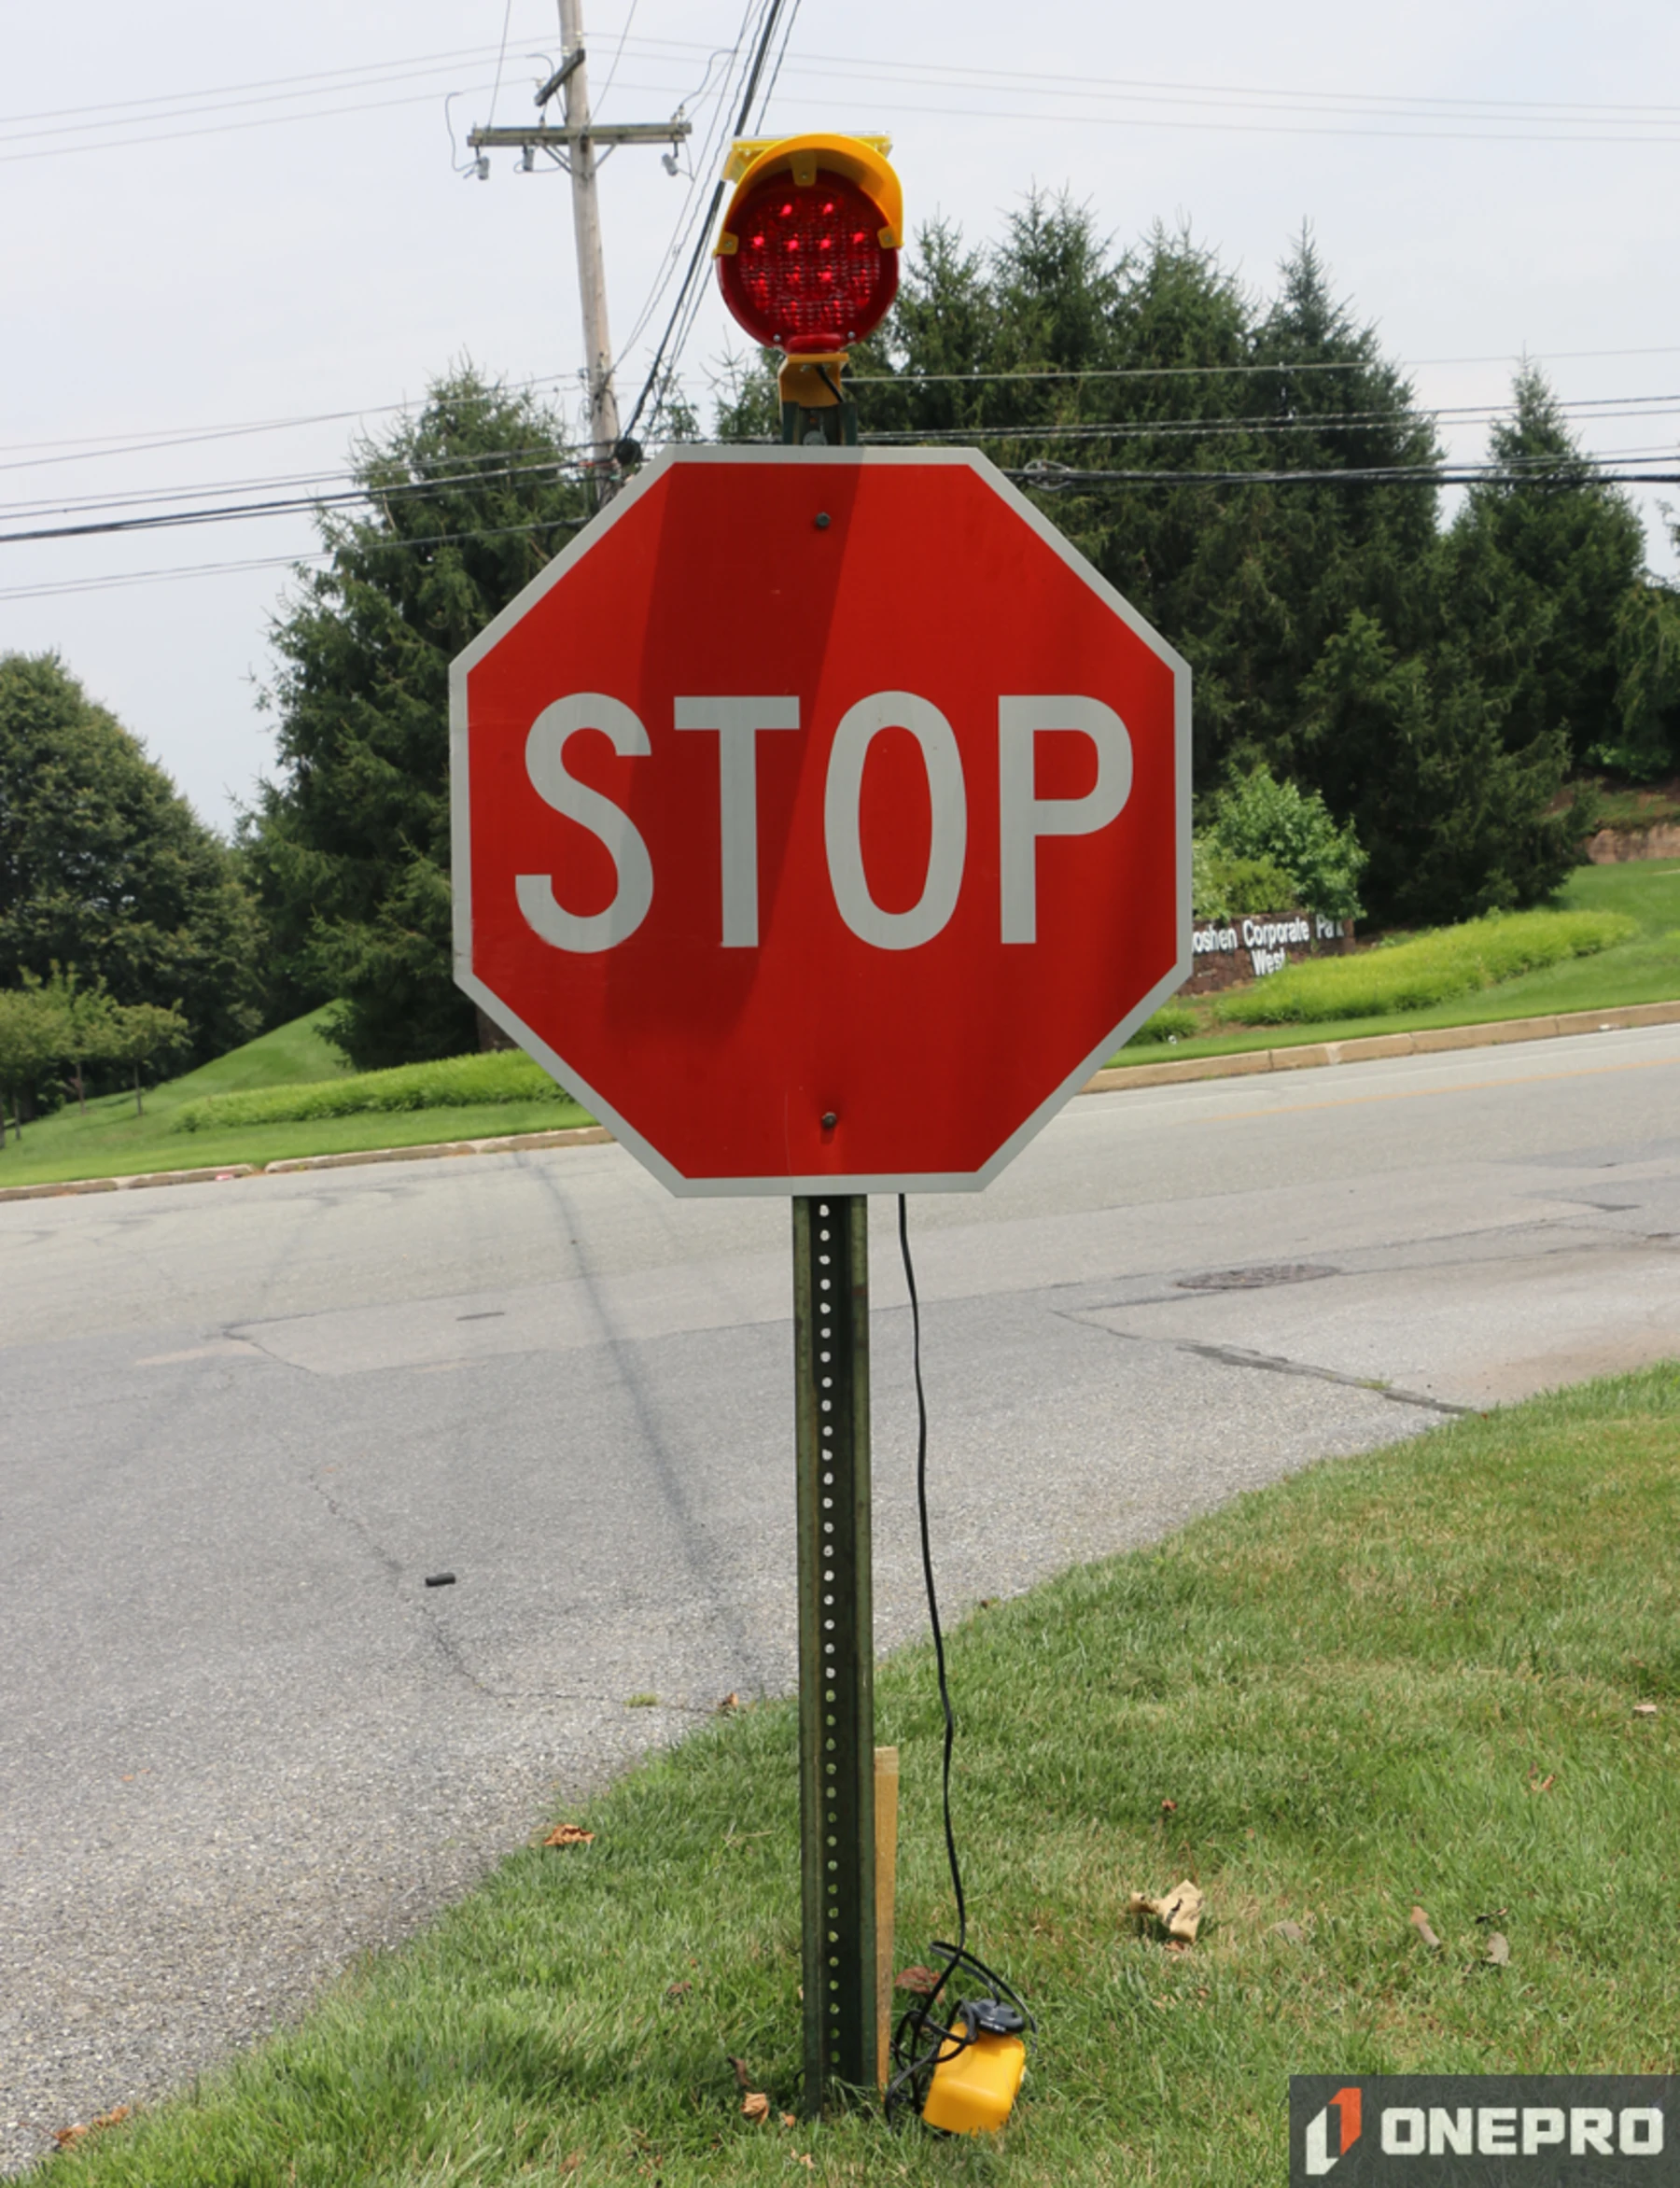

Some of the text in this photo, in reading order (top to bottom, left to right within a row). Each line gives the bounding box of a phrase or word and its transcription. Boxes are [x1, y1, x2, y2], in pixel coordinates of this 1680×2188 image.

[515, 691, 1133, 953] STOP
[1192, 924, 1238, 952] oshen
[1242, 918, 1309, 949] Corporate
[1251, 948, 1285, 976] West
